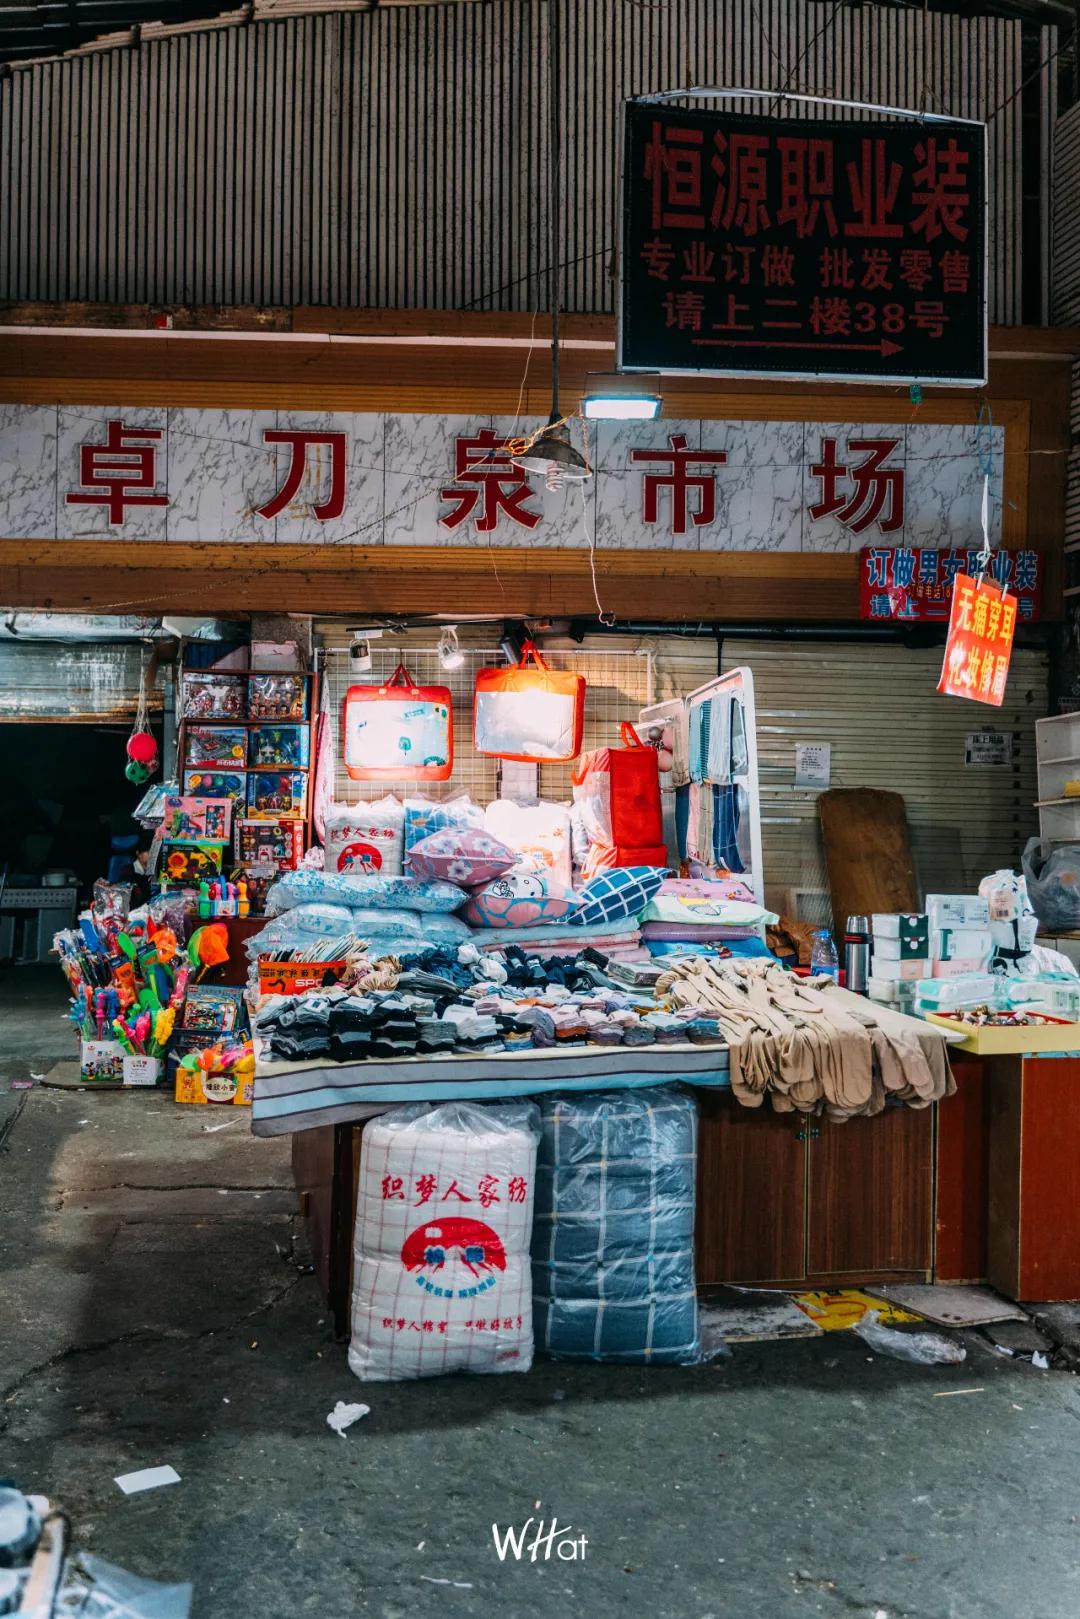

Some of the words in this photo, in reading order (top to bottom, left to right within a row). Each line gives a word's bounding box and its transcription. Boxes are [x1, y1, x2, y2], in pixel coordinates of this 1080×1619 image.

[643, 121, 970, 243] 恒源职业装
[640, 237, 796, 287] 专业订做
[819, 246, 971, 293] 批发零售
[661, 291, 950, 338] 请上二楼38号
[65, 419, 905, 535] 卓刀泉市场
[956, 587, 1014, 647] 无痛穿耳
[381, 1173, 529, 1209] 织梦人家纺
